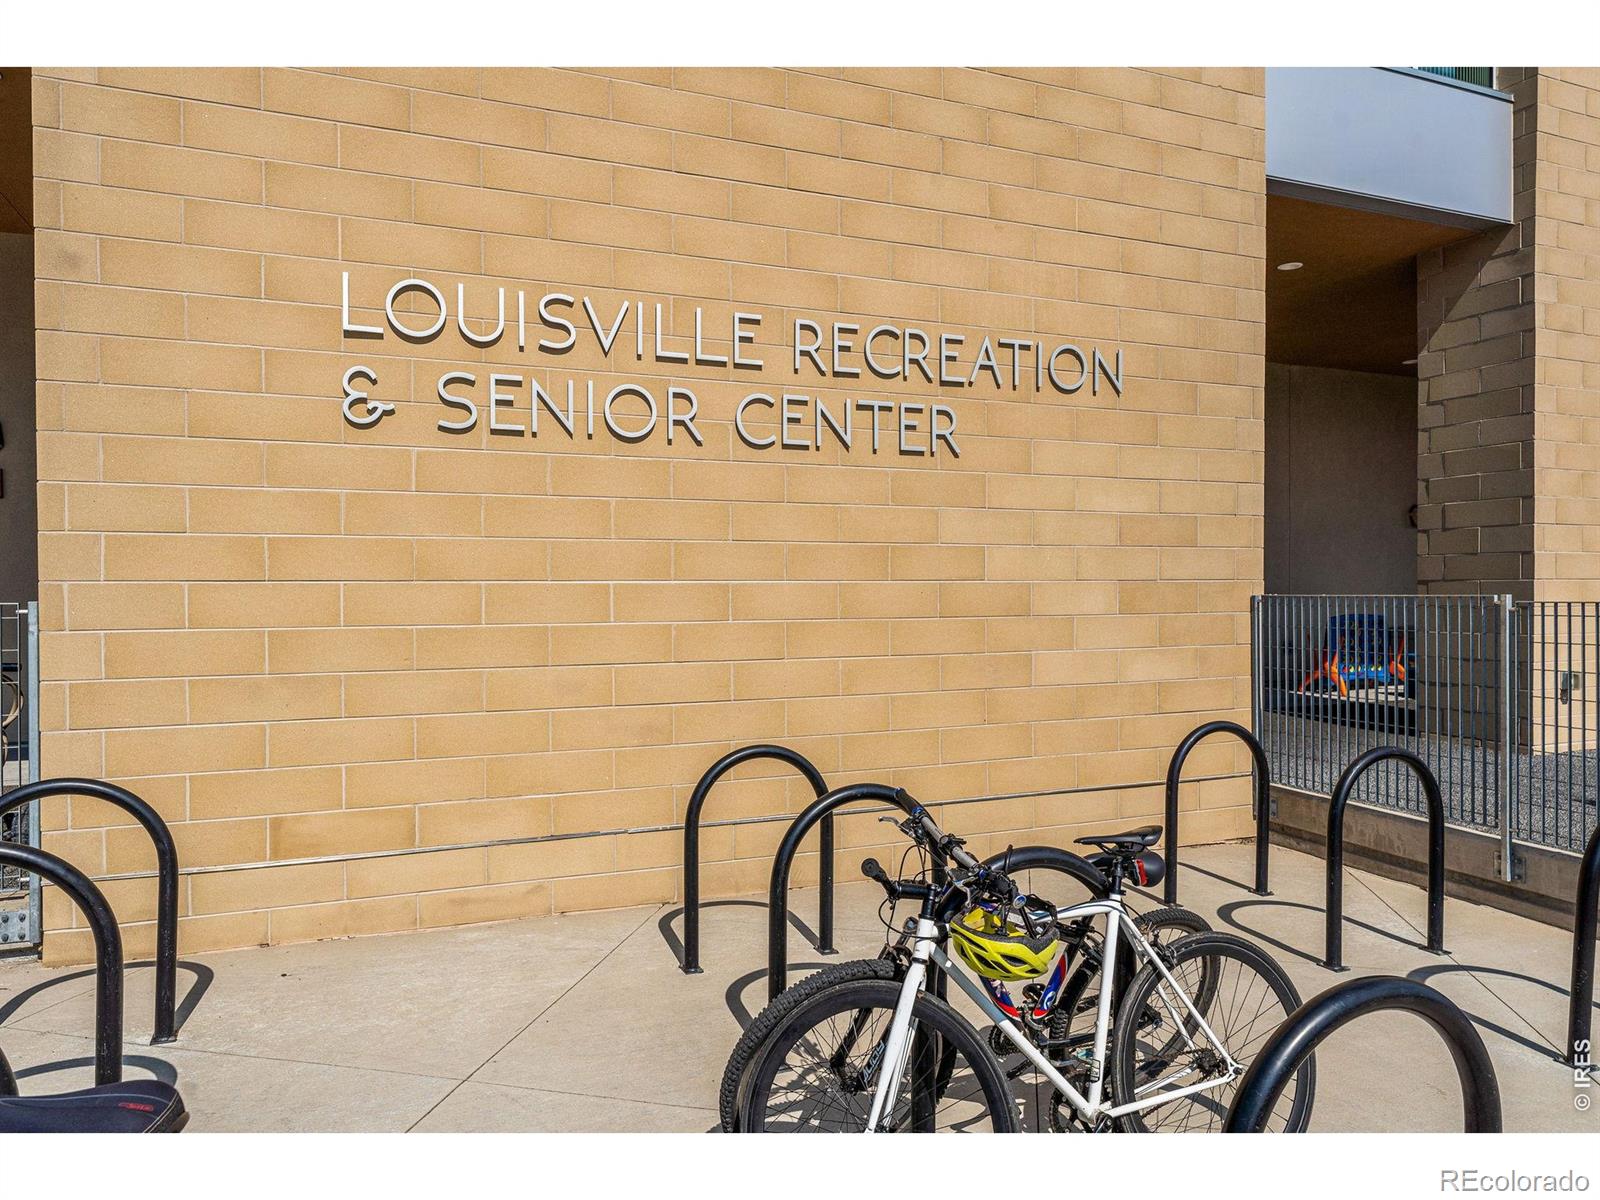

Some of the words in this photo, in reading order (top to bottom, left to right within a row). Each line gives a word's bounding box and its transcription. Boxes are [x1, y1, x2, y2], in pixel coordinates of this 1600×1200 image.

[342, 271, 764, 368] LOUISVILLE
[794, 317, 1123, 396] RECREATION
[342, 365, 395, 427] &
[437, 371, 703, 446] SENIOR
[735, 393, 960, 457] CENTER
